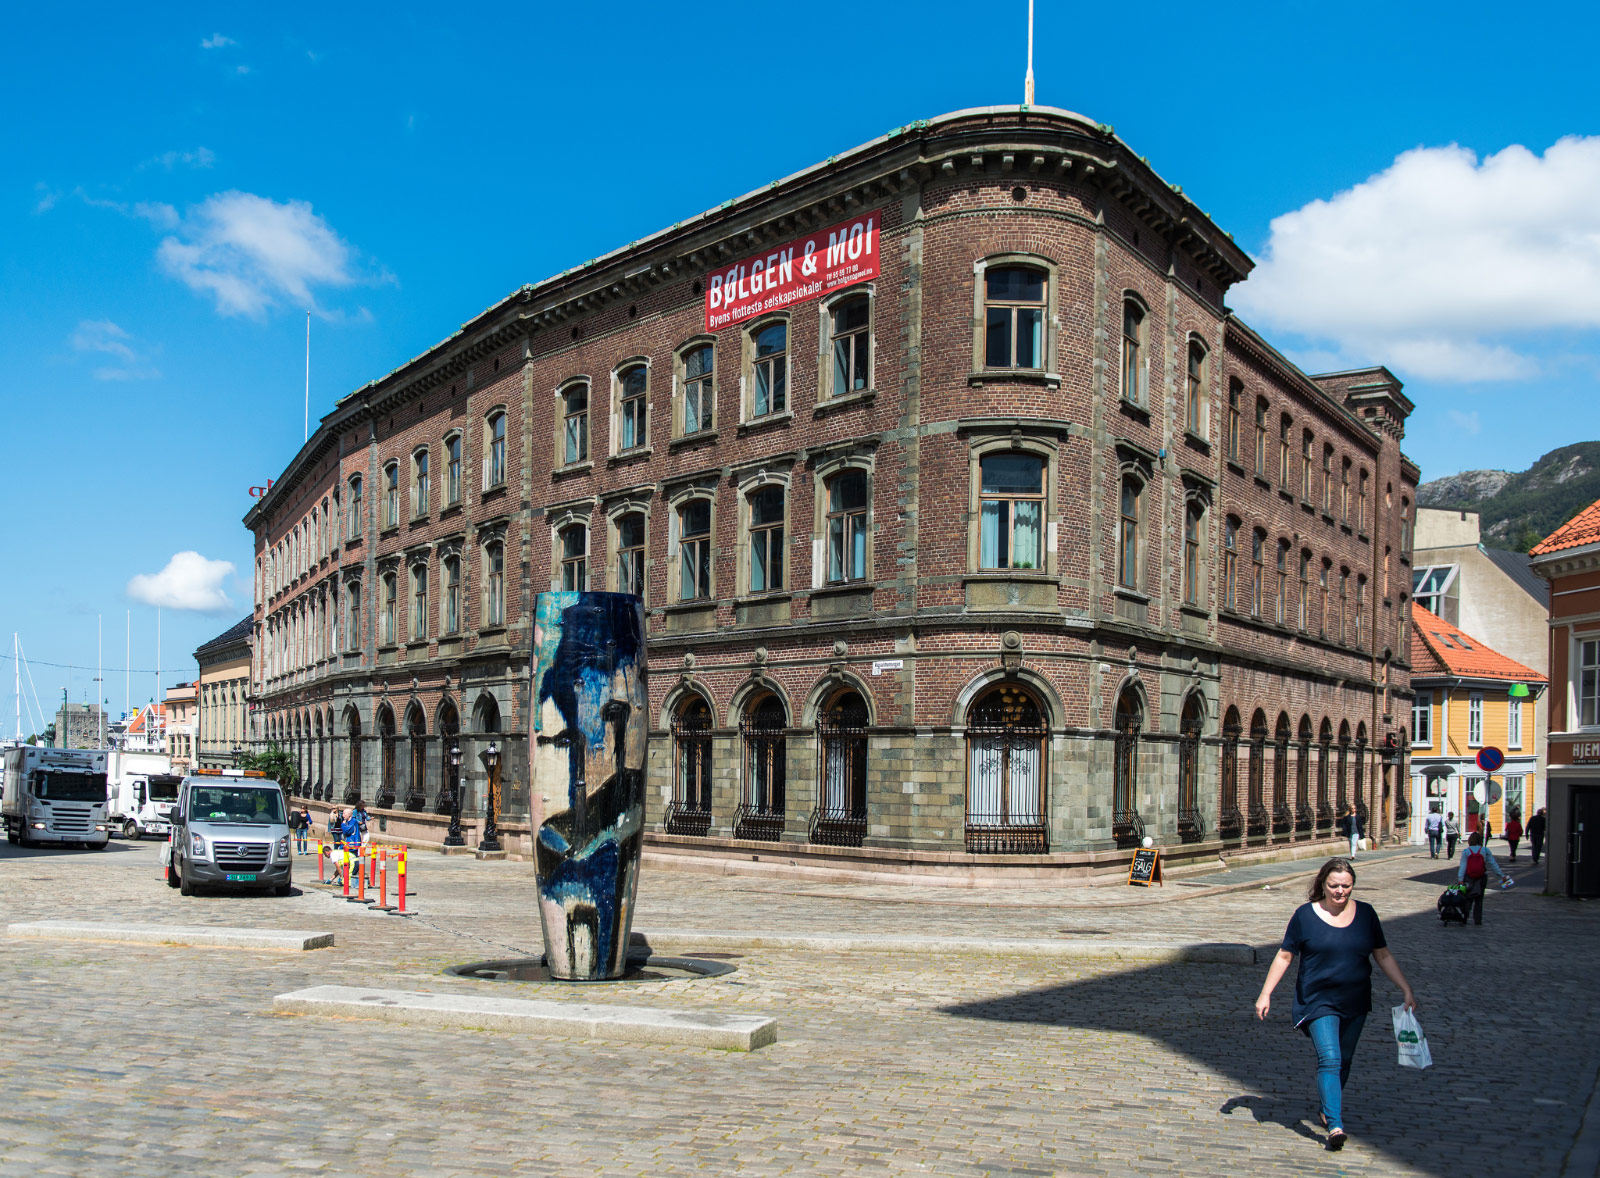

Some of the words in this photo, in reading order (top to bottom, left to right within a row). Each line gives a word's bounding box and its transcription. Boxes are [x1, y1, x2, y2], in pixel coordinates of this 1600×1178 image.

[710, 247, 793, 310] BØLGEN
[802, 240, 818, 277] &
[826, 218, 873, 268] MOI
[709, 311, 731, 328] Byens
[732, 298, 763, 320] flotteste
[764, 280, 823, 309] selskapslokaler
[1572, 743, 1600, 759] HJEM
[1134, 861, 1153, 873] SALG
